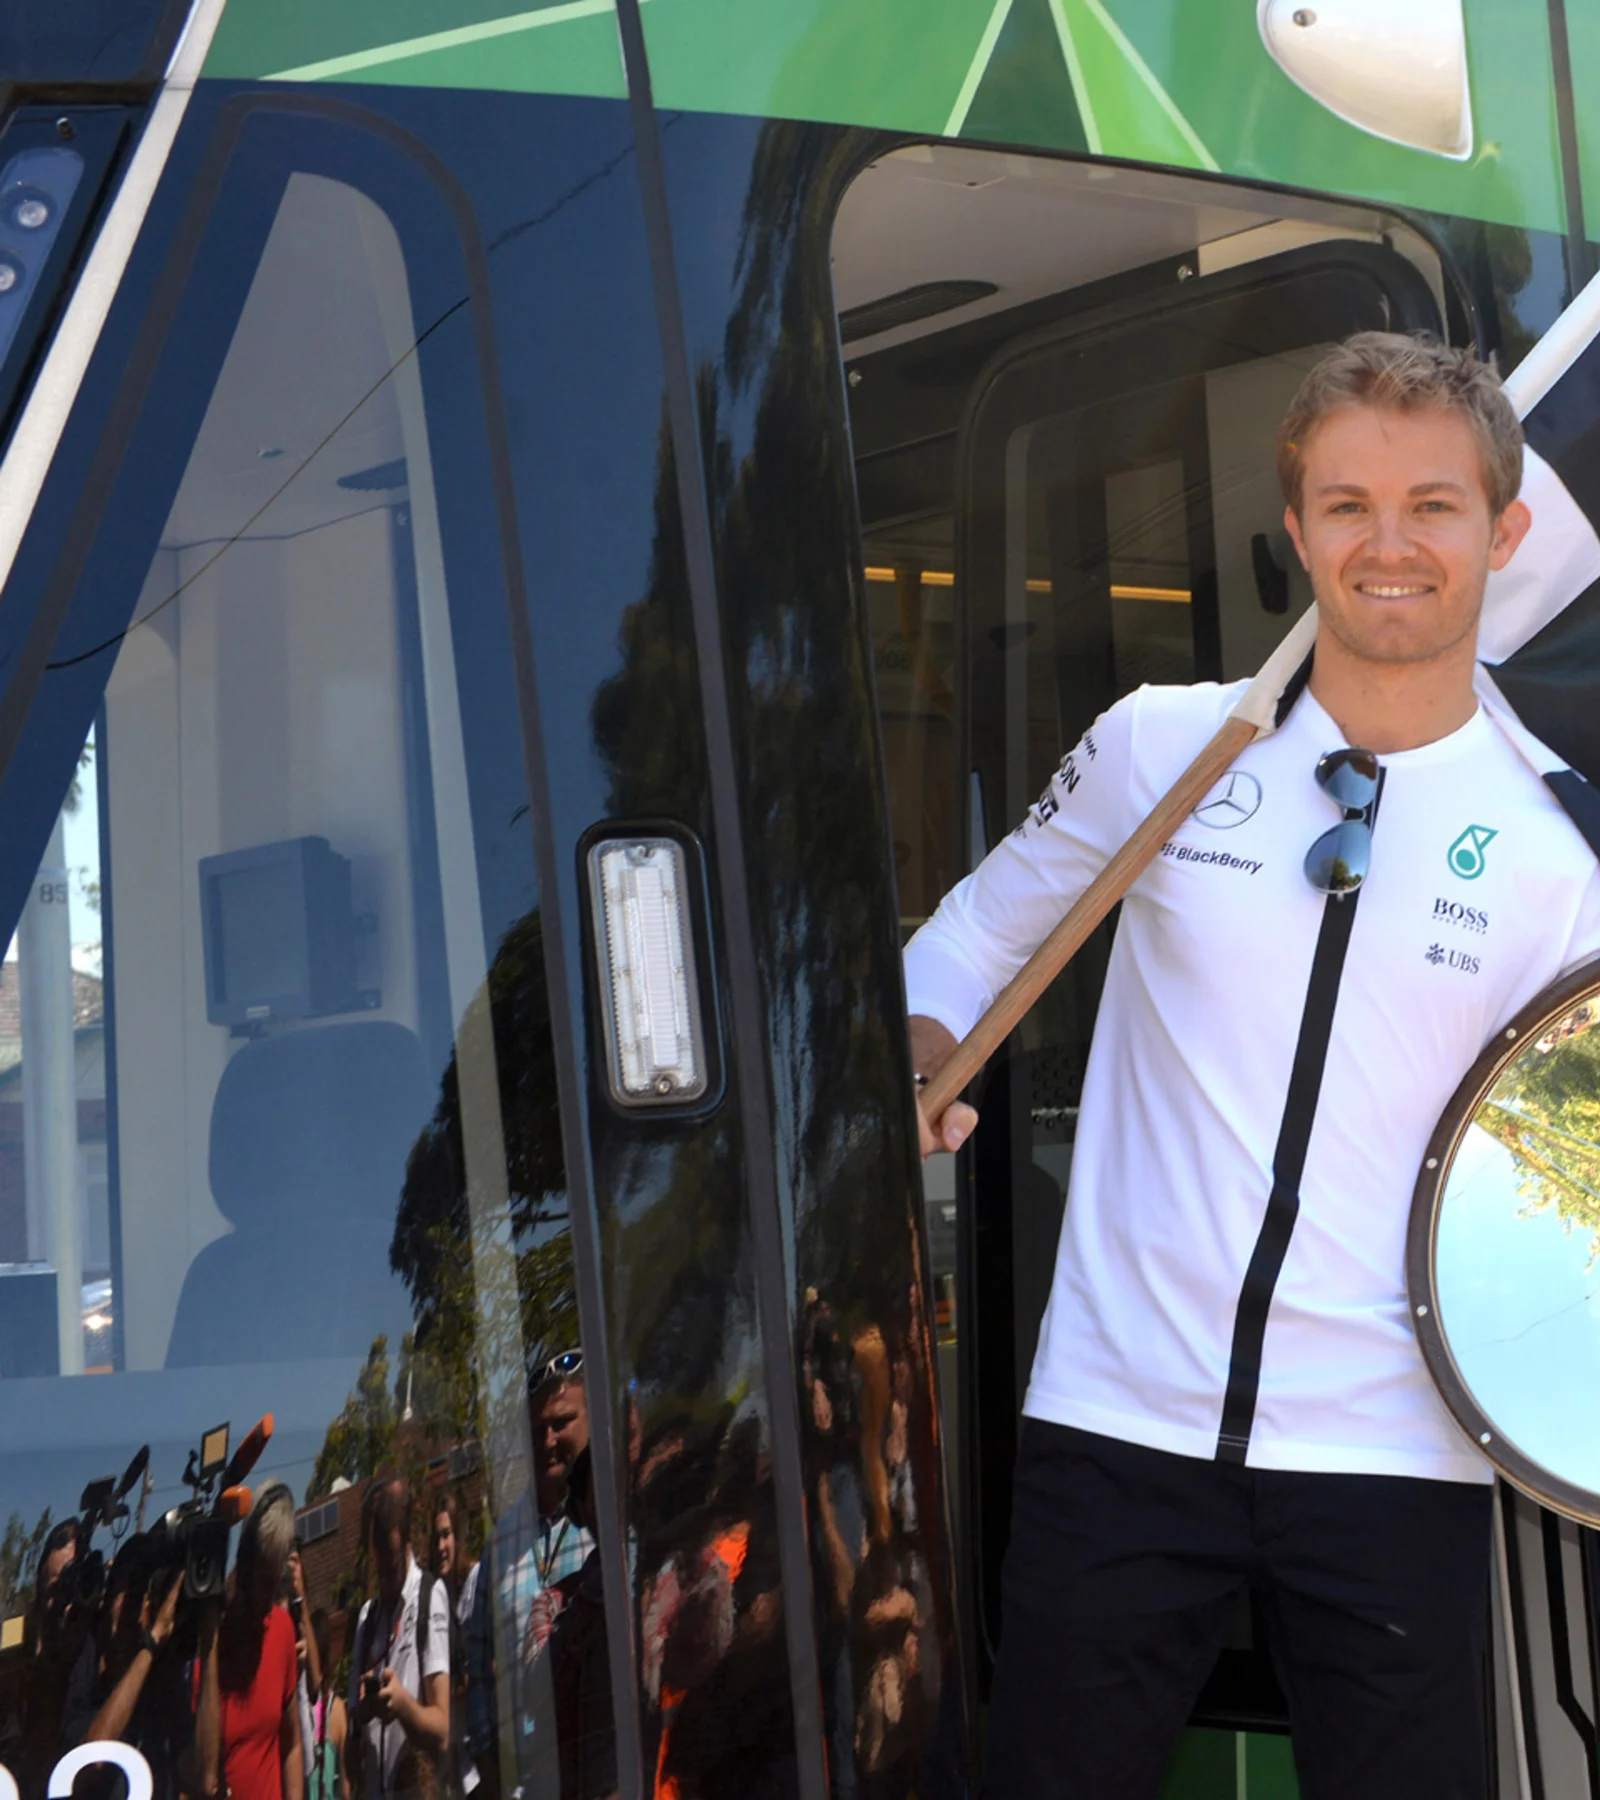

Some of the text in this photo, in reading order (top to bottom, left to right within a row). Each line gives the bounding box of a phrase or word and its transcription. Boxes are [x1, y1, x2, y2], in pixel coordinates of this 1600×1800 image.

[1176, 846, 1263, 876] BlackBerry
[1433, 897, 1488, 929] BOSS
[1448, 949, 1481, 975] UBS
